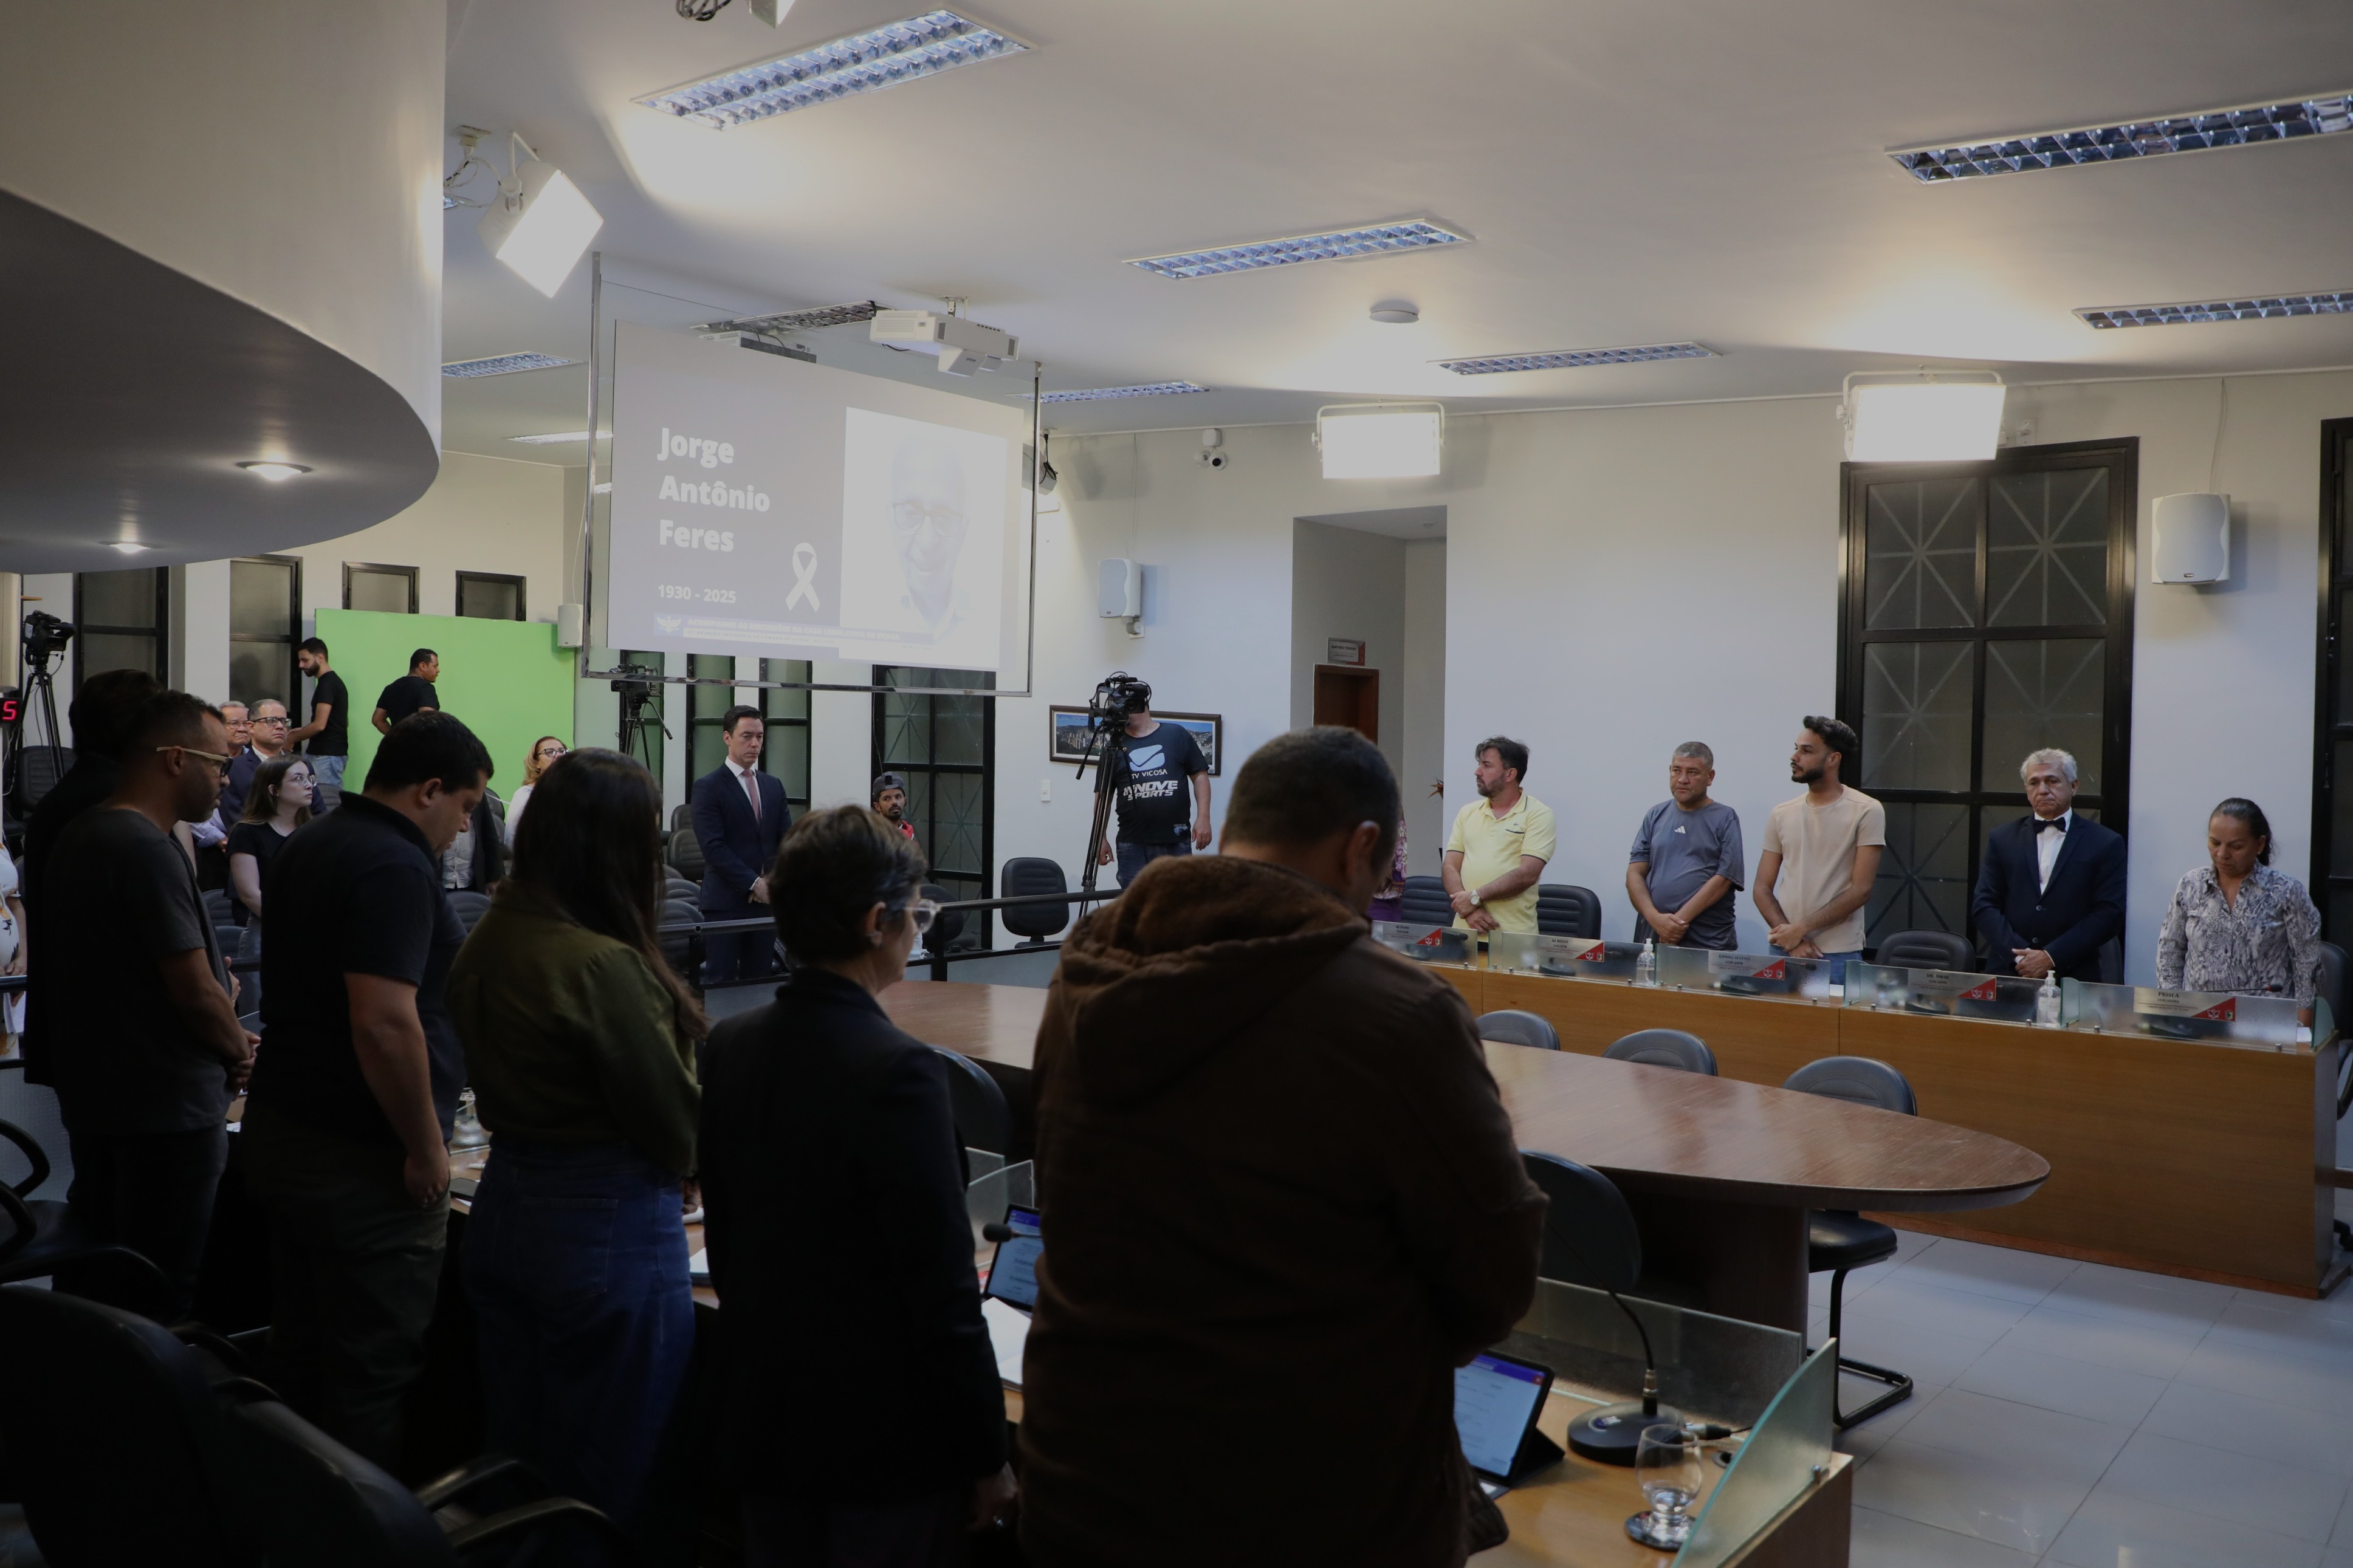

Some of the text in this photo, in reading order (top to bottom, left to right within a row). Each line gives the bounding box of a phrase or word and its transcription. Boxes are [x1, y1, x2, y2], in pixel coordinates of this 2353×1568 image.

[657, 428, 734, 468] Jorge
[659, 475, 770, 512] Antônio
[659, 519, 734, 552] Feres
[658, 584, 692, 600] 1930
[703, 589, 737, 604] 2025
[2, 700, 18, 721] 5
[1141, 769, 1168, 777] VIÇOSA
[1127, 789, 1174, 801] SPORTS
